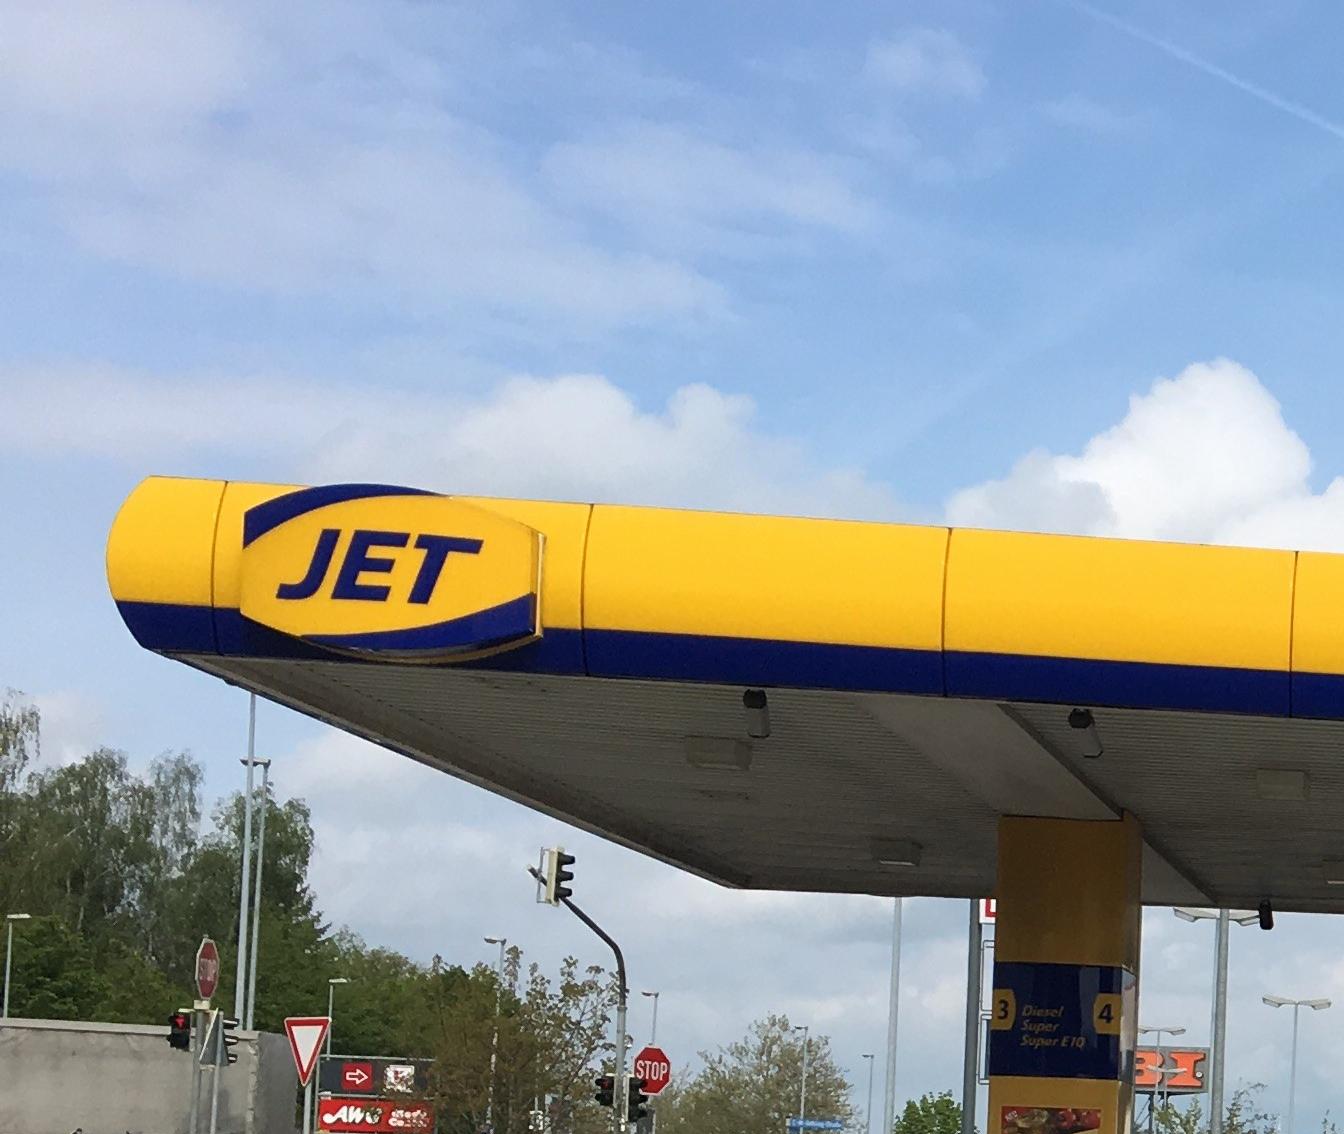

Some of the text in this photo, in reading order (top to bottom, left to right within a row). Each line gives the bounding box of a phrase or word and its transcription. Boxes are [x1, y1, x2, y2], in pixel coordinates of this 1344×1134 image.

[275, 528, 485, 605] JET
[998, 999, 1009, 1020] 3
[1021, 1004, 1065, 1018] Diesel
[1098, 1003, 1114, 1024] 4
[1020, 1019, 1060, 1035] Super
[1020, 1035, 1087, 1049] Super E10
[636, 1060, 668, 1081] STOP
[1135, 1050, 1206, 1089] BI
